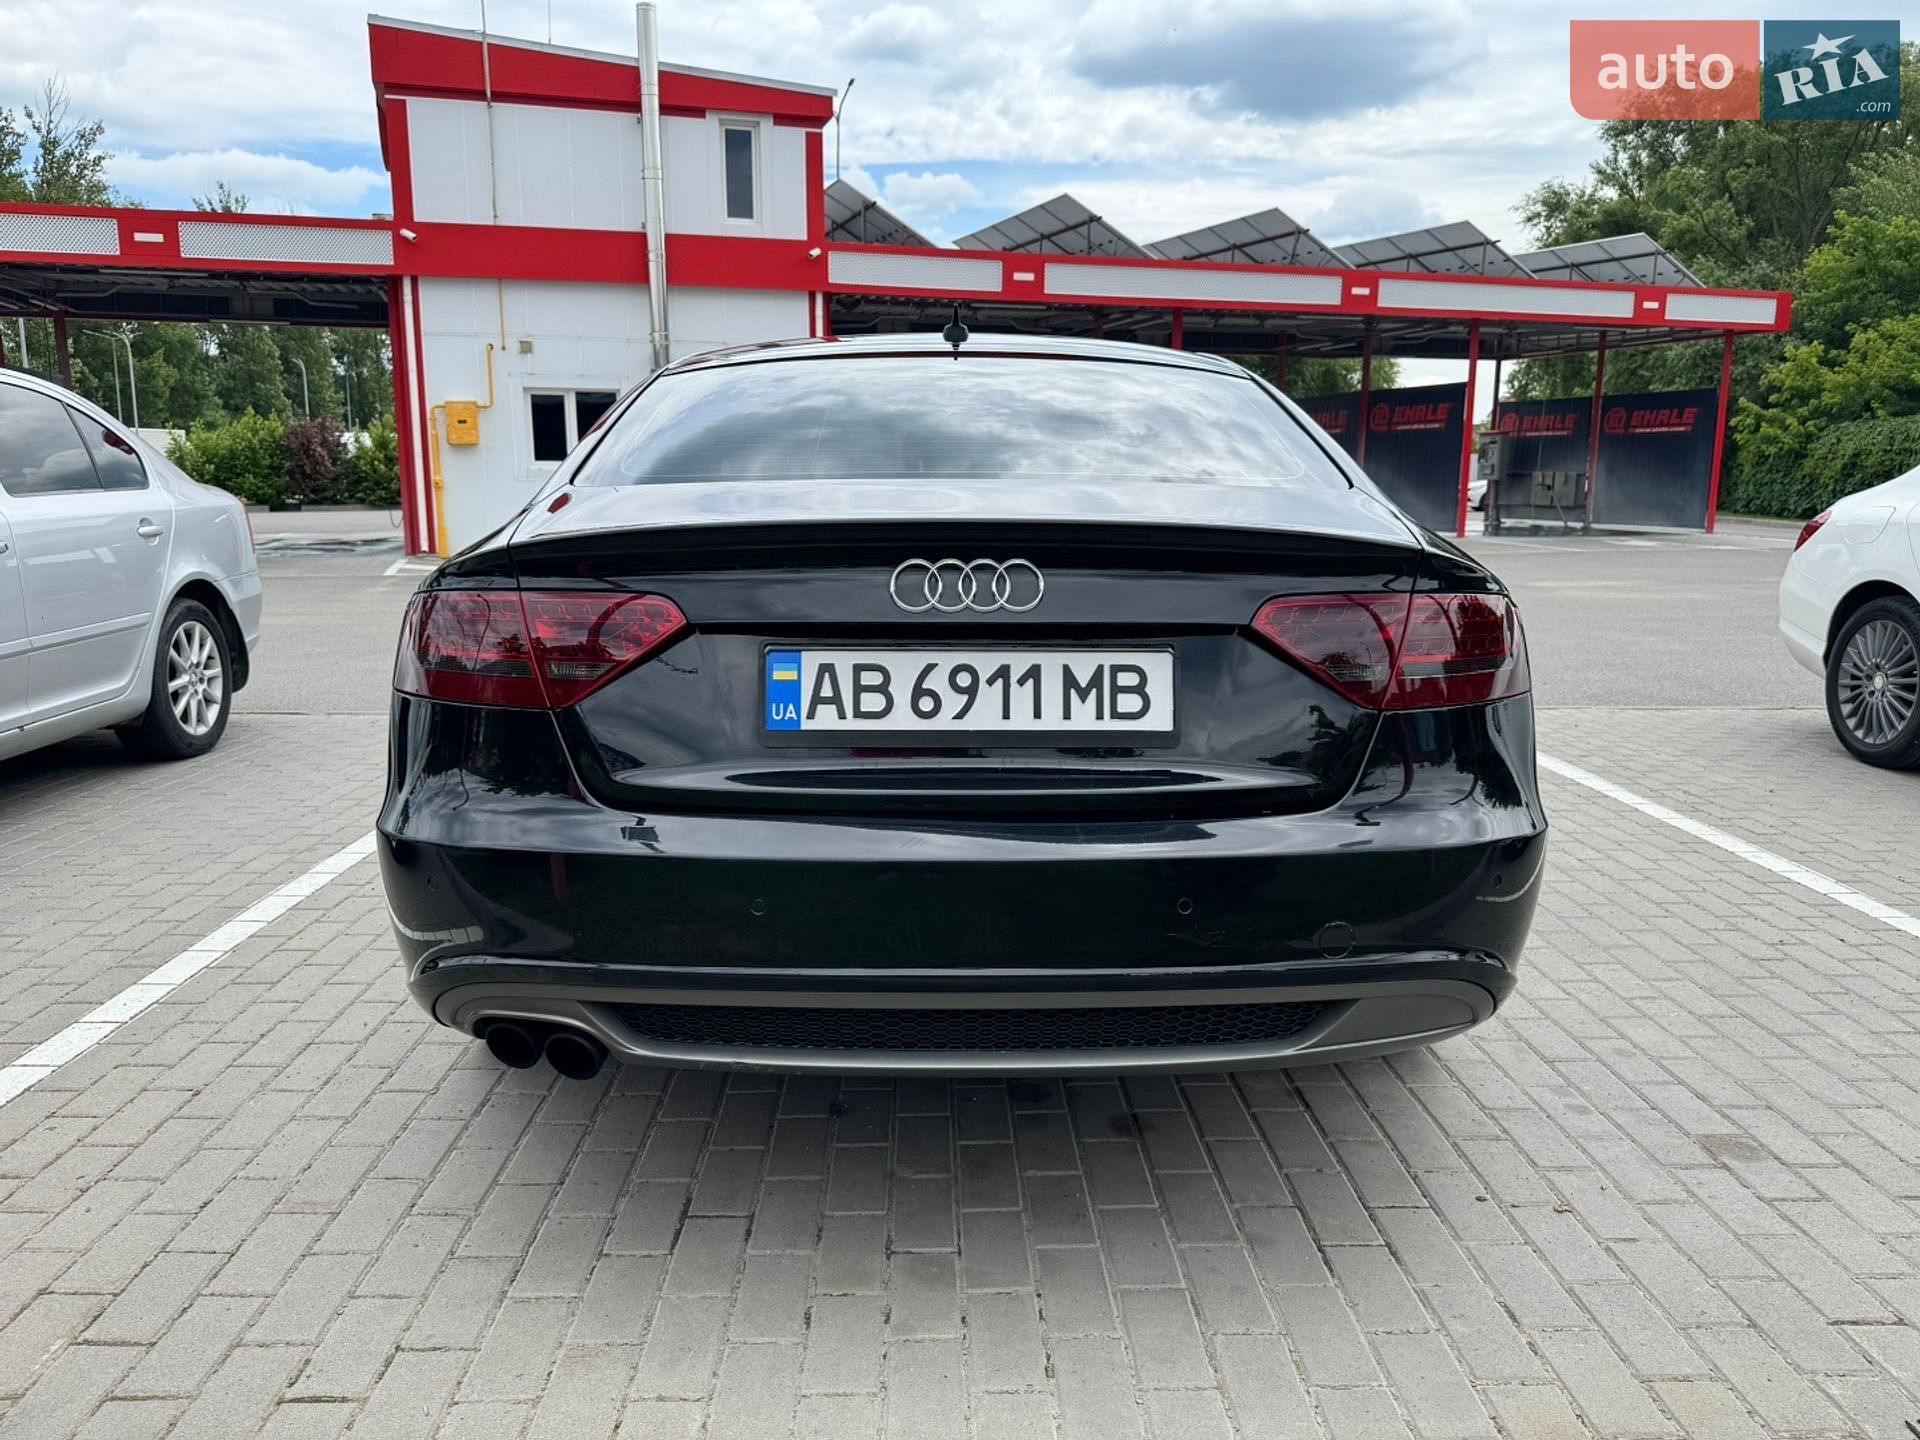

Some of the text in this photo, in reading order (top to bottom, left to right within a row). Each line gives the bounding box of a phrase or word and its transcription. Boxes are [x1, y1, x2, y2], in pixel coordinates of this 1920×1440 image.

[1630, 407, 1697, 426] EHRLE
[805, 663, 1151, 720] AB 6911 MB
[772, 703, 798, 721] UA
